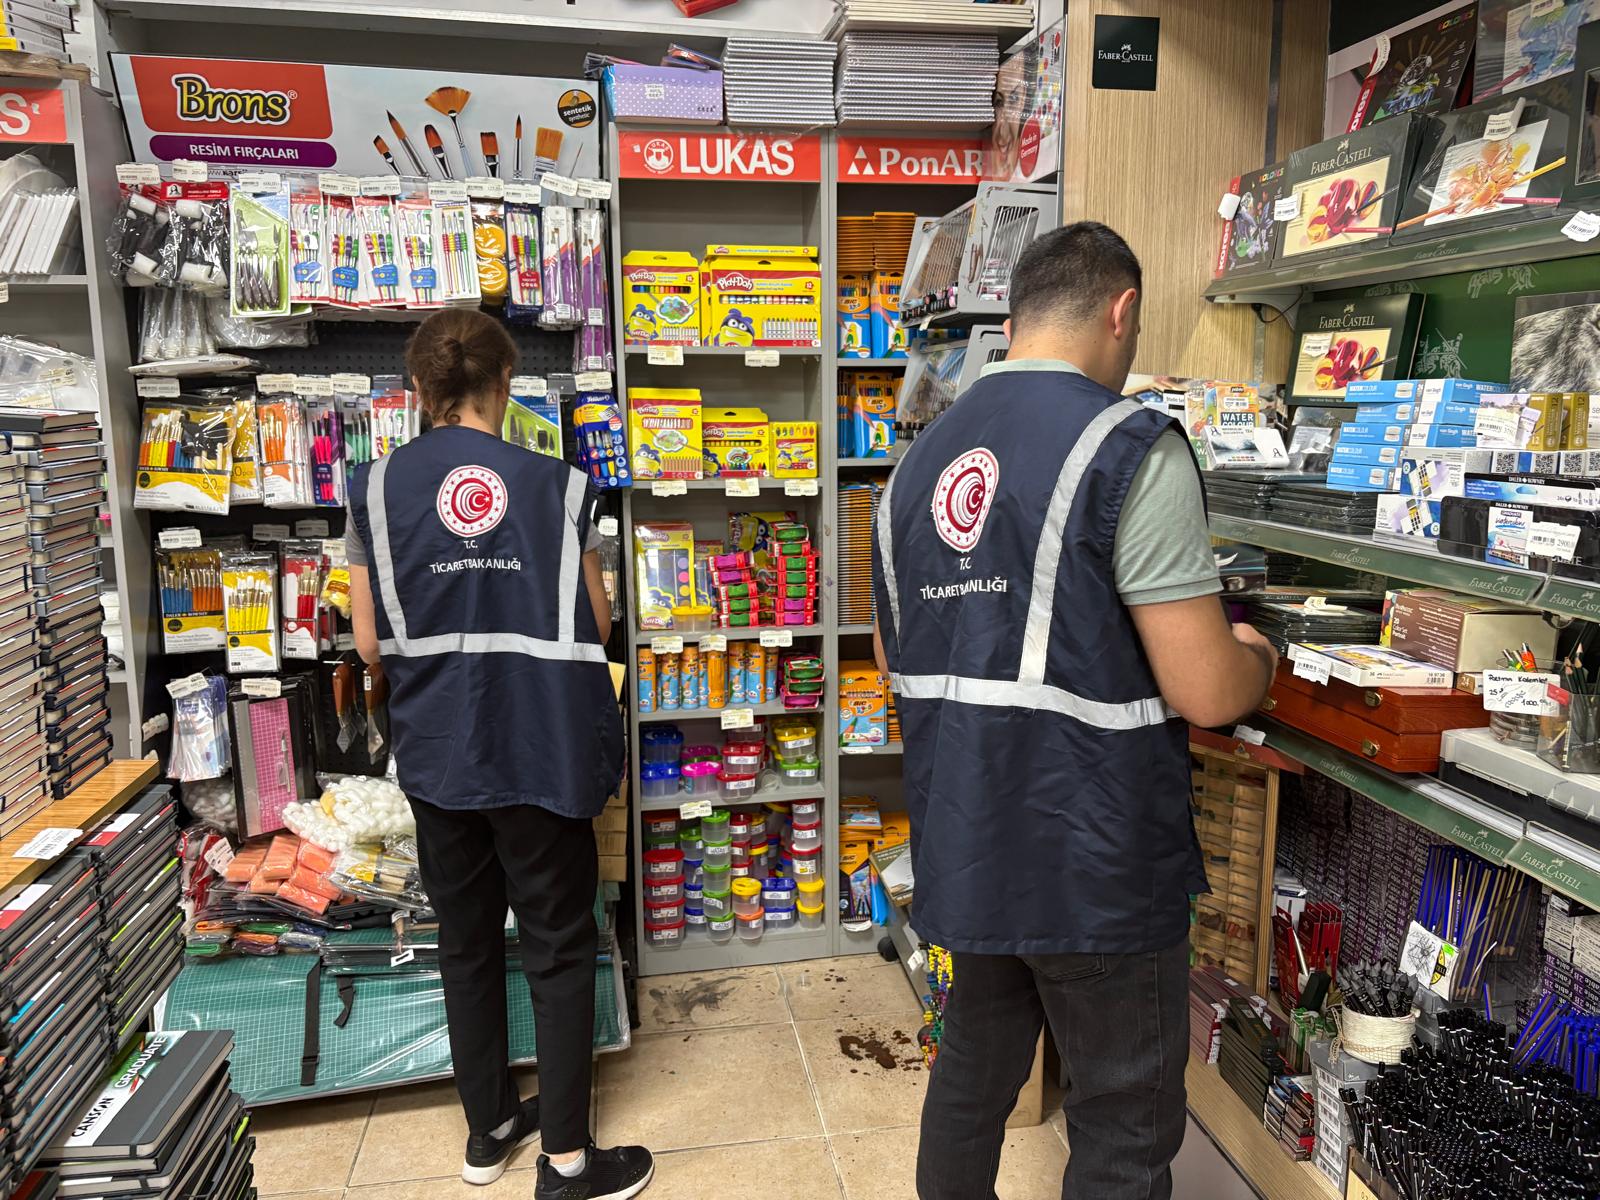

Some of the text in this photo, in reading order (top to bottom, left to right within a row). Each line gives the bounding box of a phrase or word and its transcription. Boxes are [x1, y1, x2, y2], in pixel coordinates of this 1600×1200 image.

[1098, 49, 1154, 63] FABER-CASTELL
[173, 76, 291, 123] Brons
[0, 92, 31, 136] S
[563, 104, 592, 117] sentetik
[190, 142, 300, 161] RESİM FIRÇALARI
[679, 137, 795, 176] LUKAS
[1311, 146, 1373, 176] FABER-CASTELL
[716, 273, 754, 292] Play-Doh
[1319, 314, 1375, 329] FABER-CASTELL
[1222, 413, 1254, 422] WATER
[202, 478, 218, 490] 50
[463, 539, 478, 550] T.C.
[1468, 577, 1526, 598] FABER-CASTELL
[1548, 593, 1600, 616] FABER-CAST
[1461, 676, 1470, 685] 24
[1450, 825, 1504, 858] FABER-CASTELL
[1519, 851, 1582, 891] FABER-CASTELL
[1584, 977, 1600, 990] able
[114, 1035, 169, 1089] GRADUATE
[71, 1096, 115, 1138] CANSON
